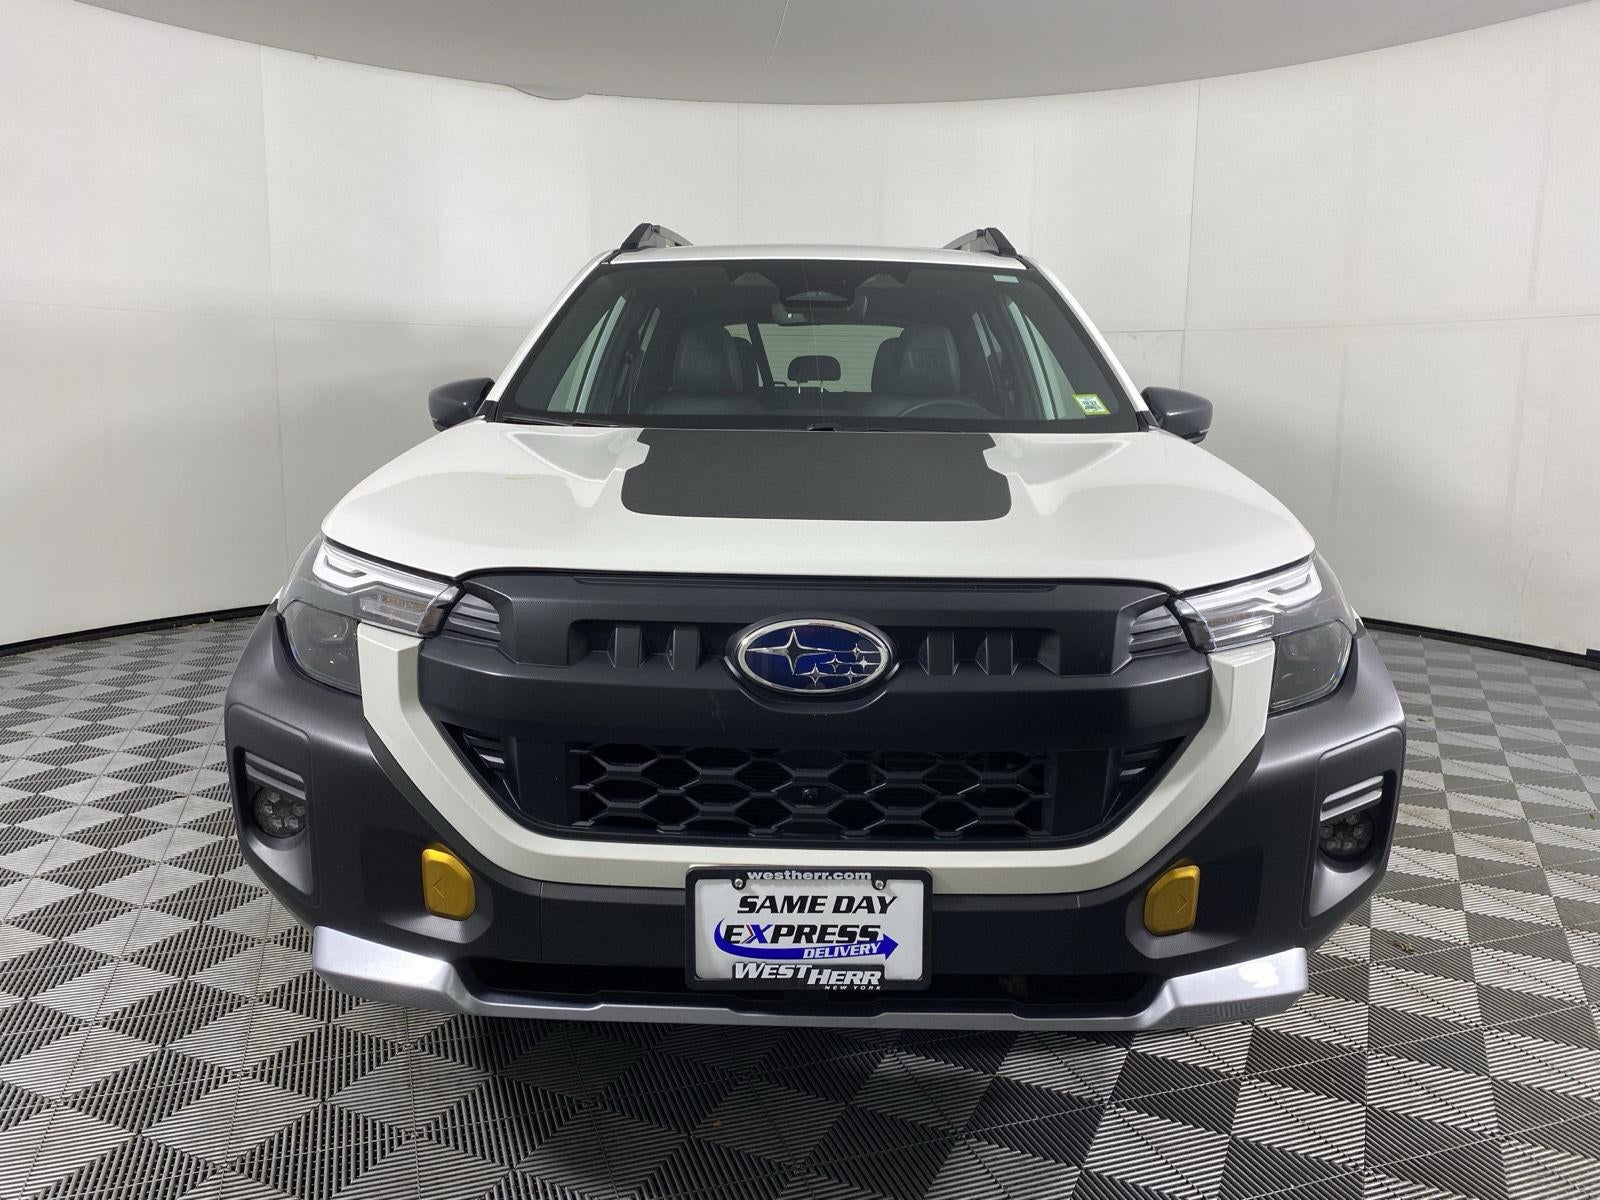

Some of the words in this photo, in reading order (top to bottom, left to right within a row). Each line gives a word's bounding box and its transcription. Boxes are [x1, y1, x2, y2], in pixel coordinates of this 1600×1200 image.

[747, 871, 872, 880] westherr.com
[737, 895, 827, 914] SAME
[832, 895, 898, 914] DAY
[724, 924, 881, 944] EXPRESS
[803, 943, 881, 959] DELIVERY
